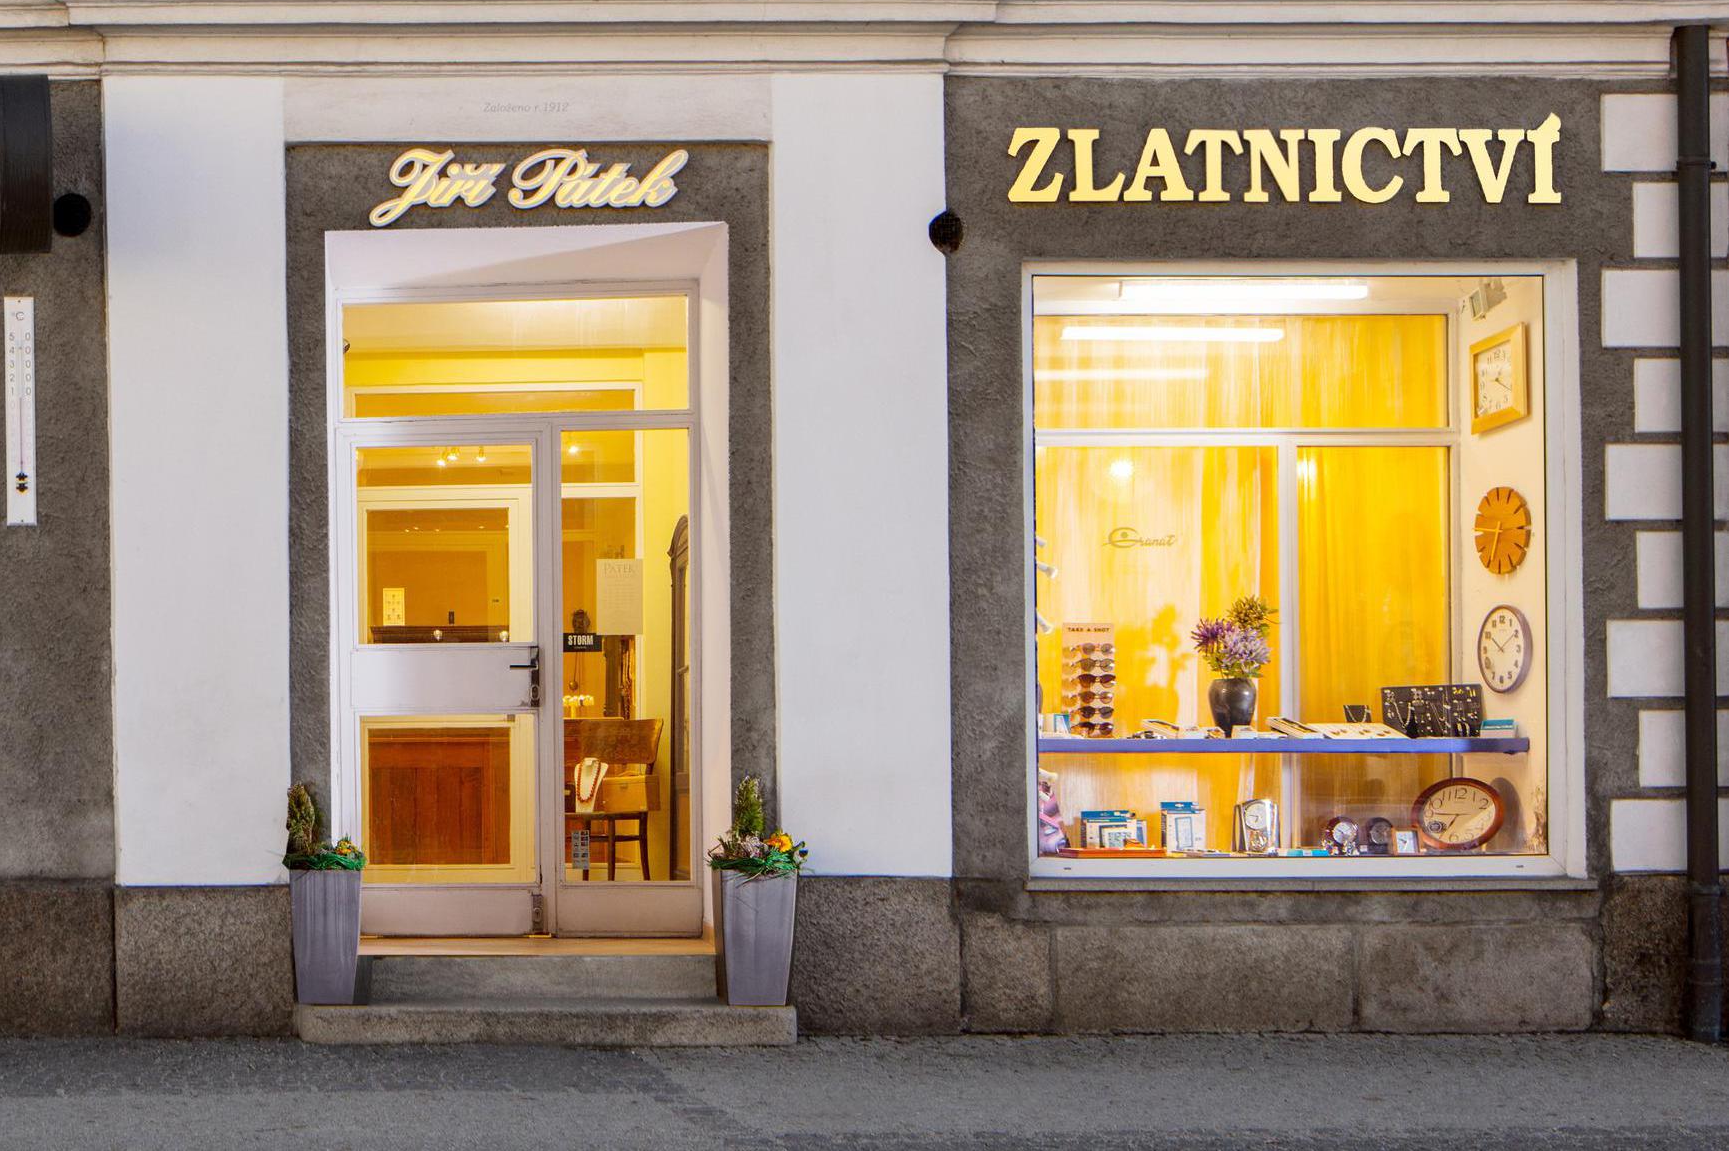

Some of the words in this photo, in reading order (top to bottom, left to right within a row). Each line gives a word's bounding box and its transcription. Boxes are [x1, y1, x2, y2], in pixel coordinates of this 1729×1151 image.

[1007, 112, 1562, 204] ZLATNICTVÍ
[369, 148, 506, 227] Jiří
[508, 148, 689, 209] Pátek
[567, 634, 594, 646] STORM
[1454, 787, 1468, 800] 12
[1478, 797, 1489, 810] 2
